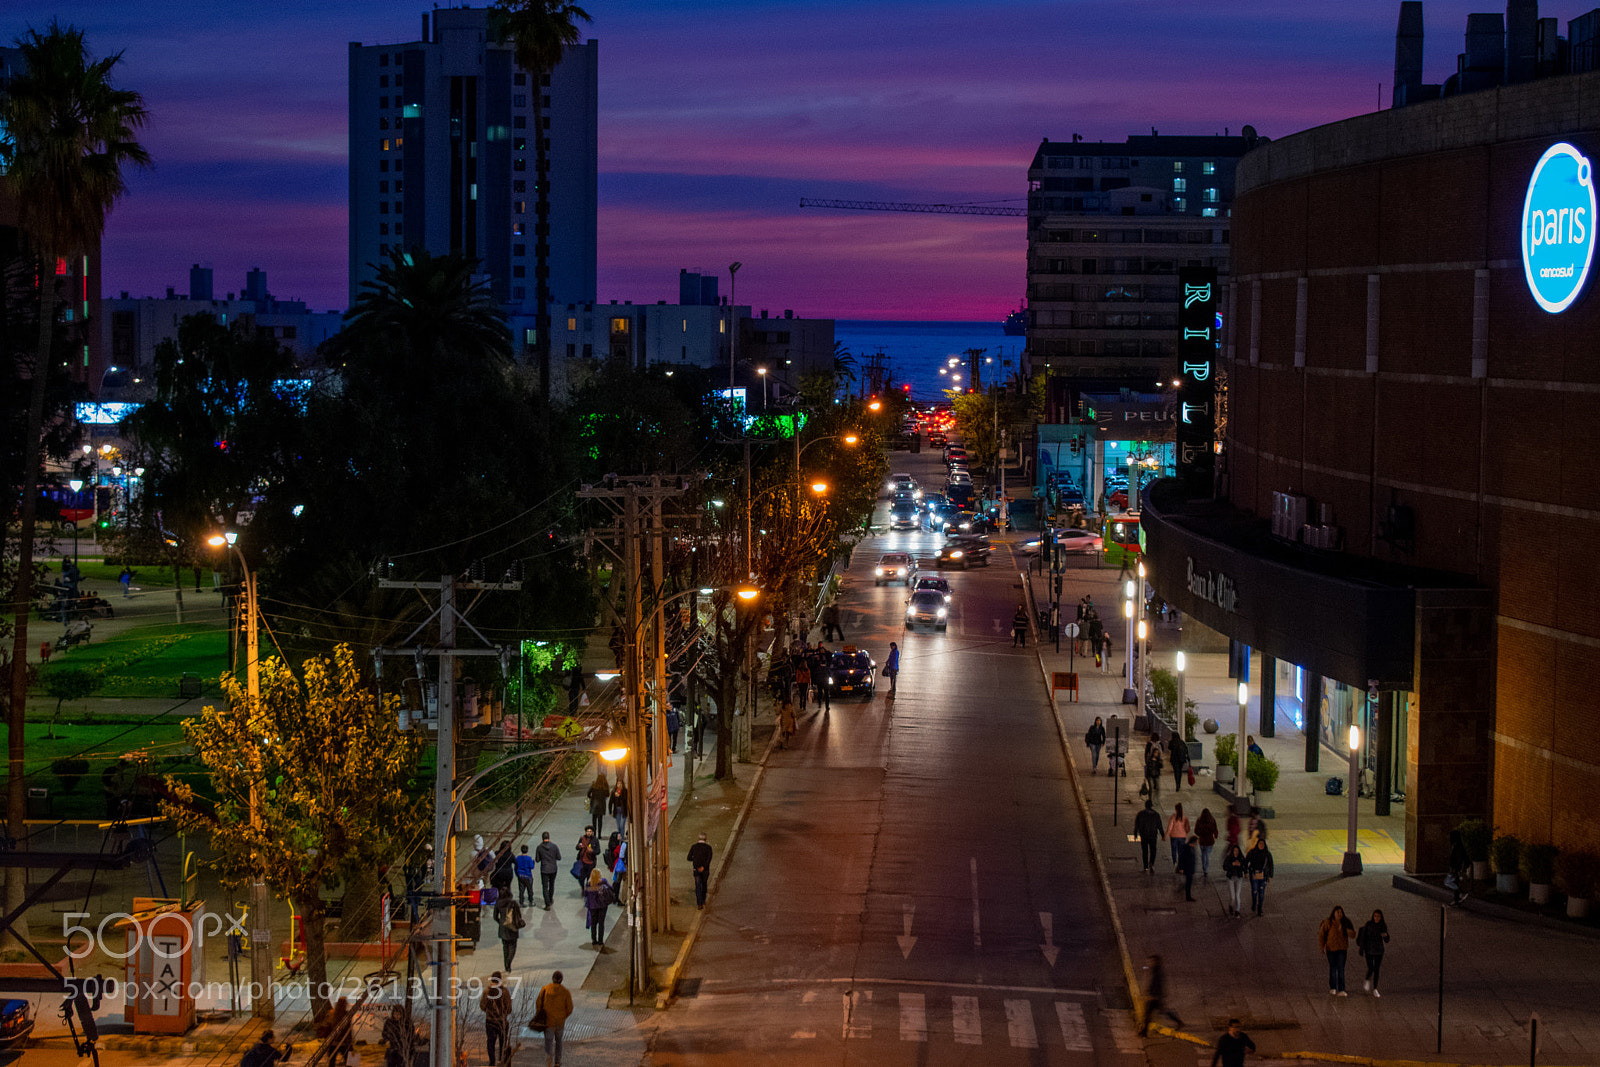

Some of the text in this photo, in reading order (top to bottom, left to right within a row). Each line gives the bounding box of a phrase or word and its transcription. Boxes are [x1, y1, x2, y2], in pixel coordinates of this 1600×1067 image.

[1531, 207, 1586, 257] paris
[1540, 264, 1574, 278] cencosud
[157, 942, 178, 1011] TAXI
